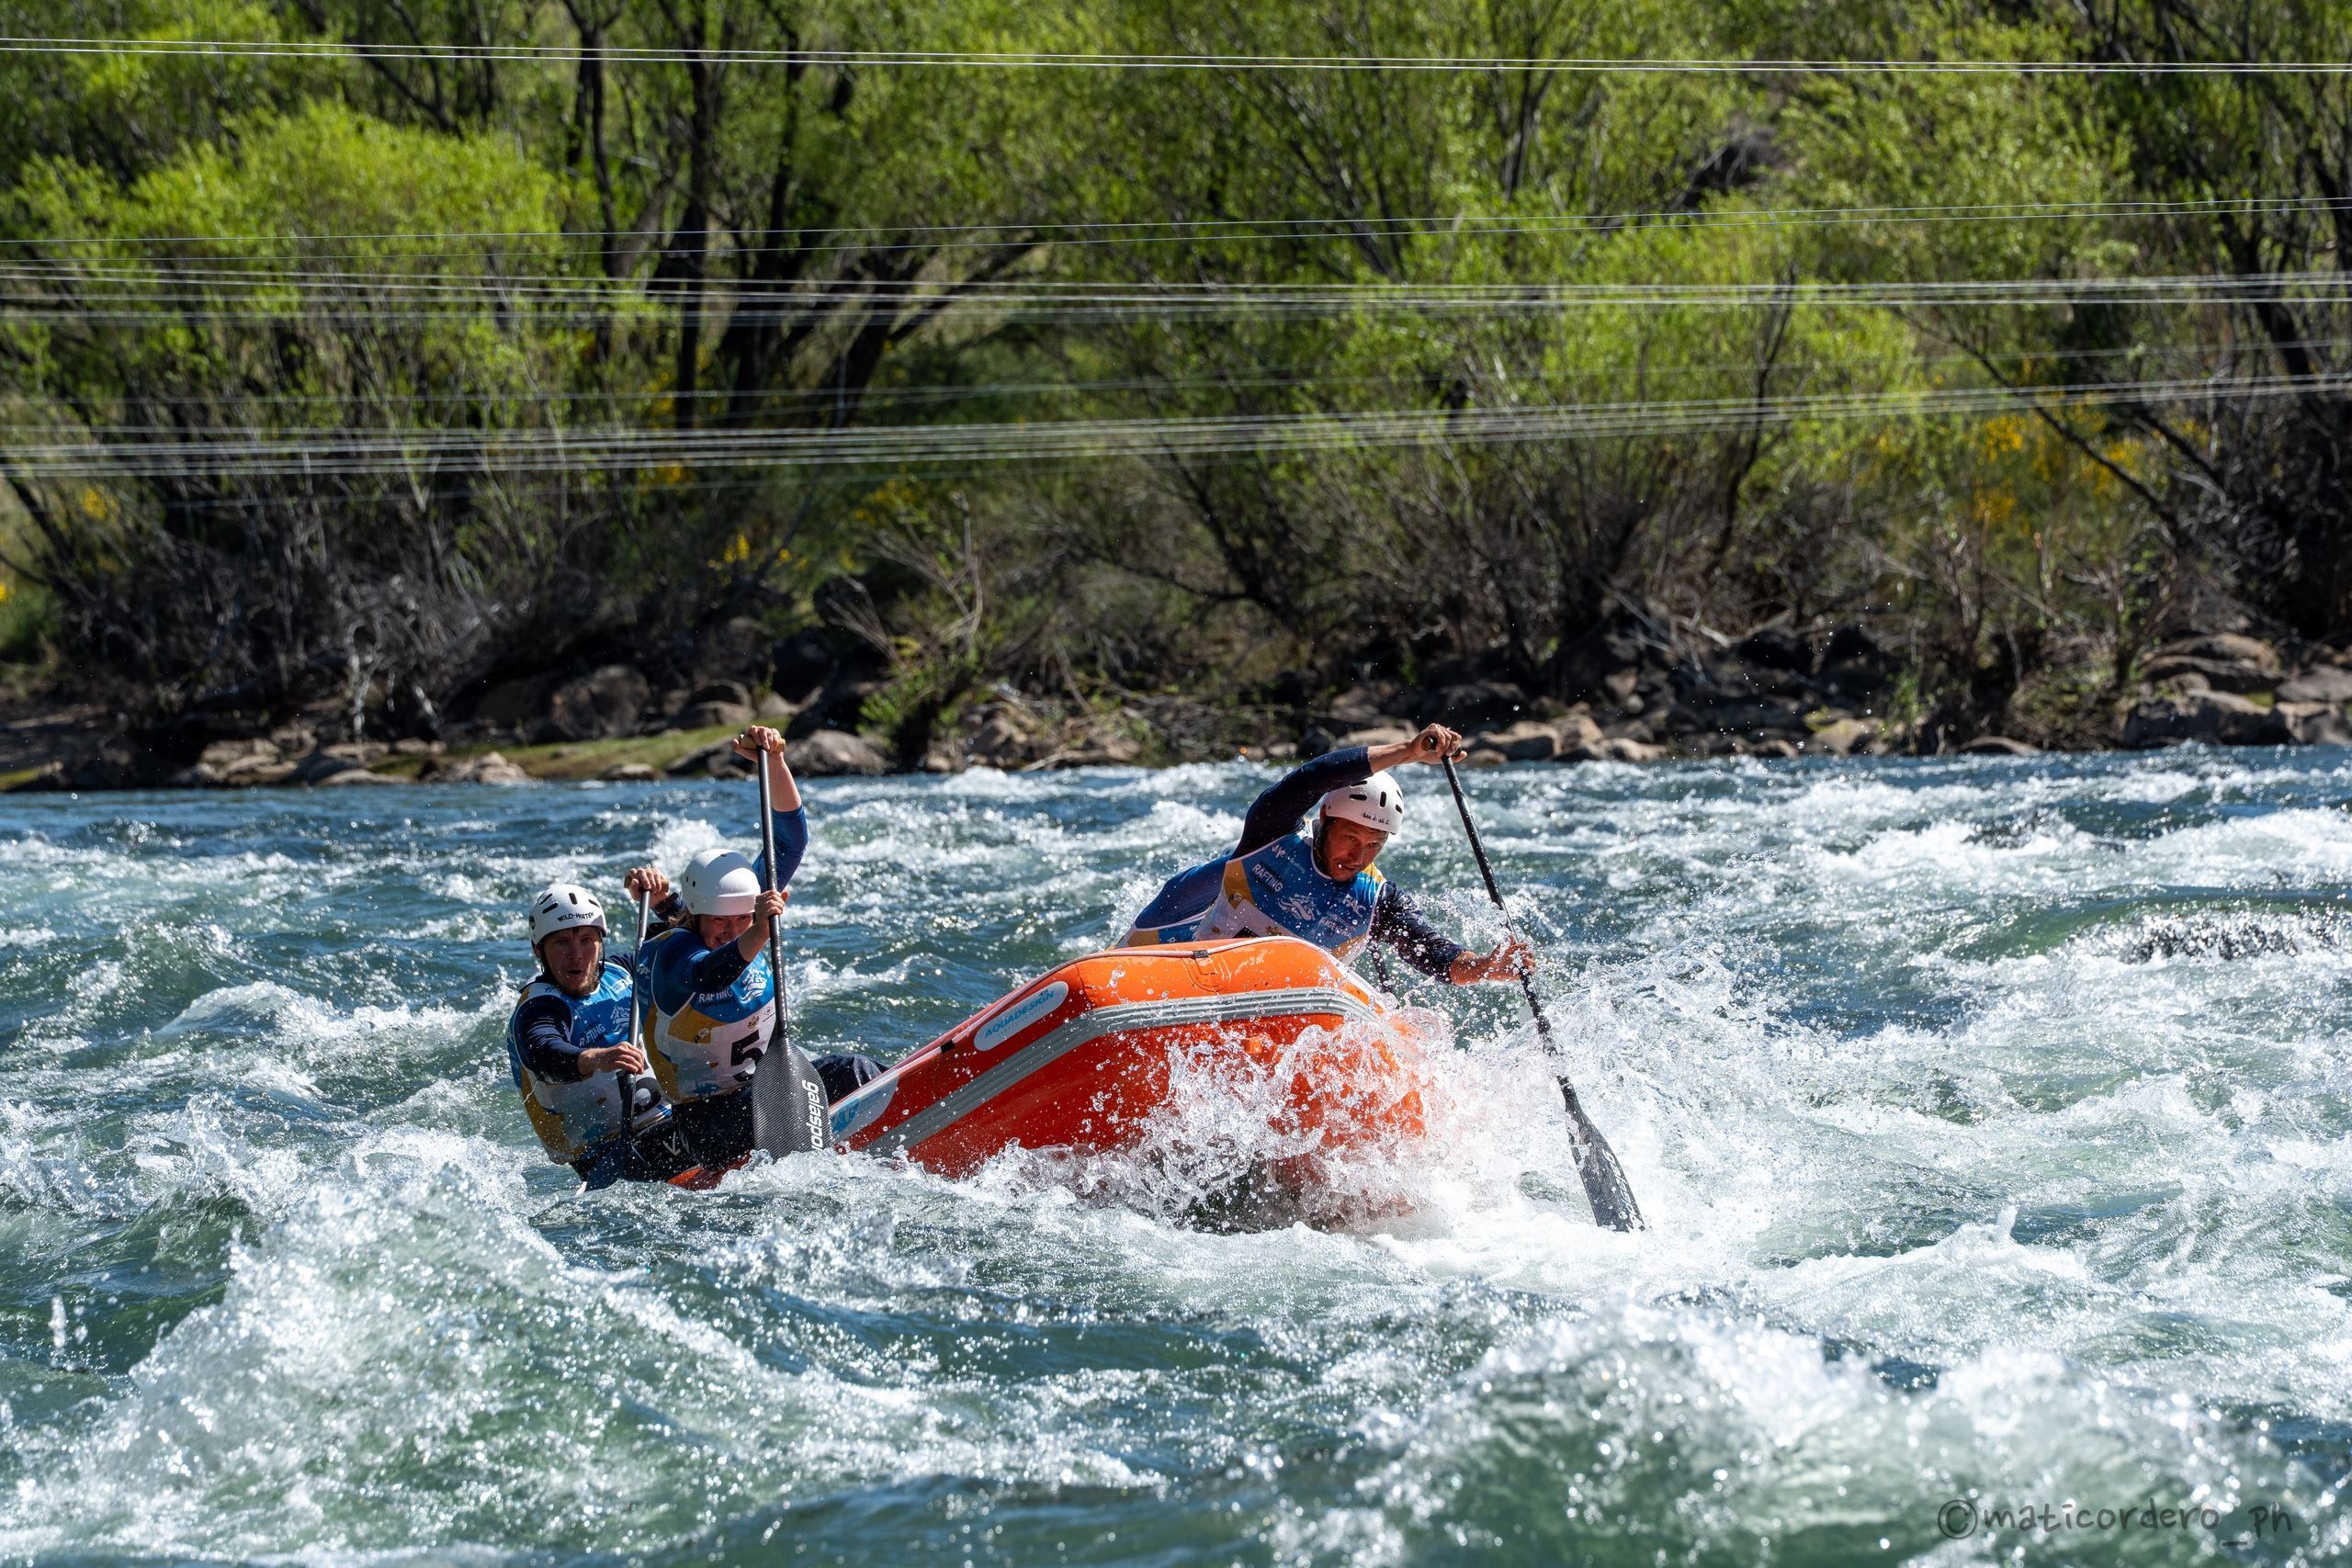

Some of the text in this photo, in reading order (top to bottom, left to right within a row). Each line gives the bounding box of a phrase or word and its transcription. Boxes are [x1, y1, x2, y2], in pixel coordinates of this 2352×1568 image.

[1251, 863, 1283, 893] RAFTING
[984, 989, 1055, 1039] AQUADESIGN
[580, 1023, 606, 1046] RFTING
[730, 1029, 764, 1082] 5
